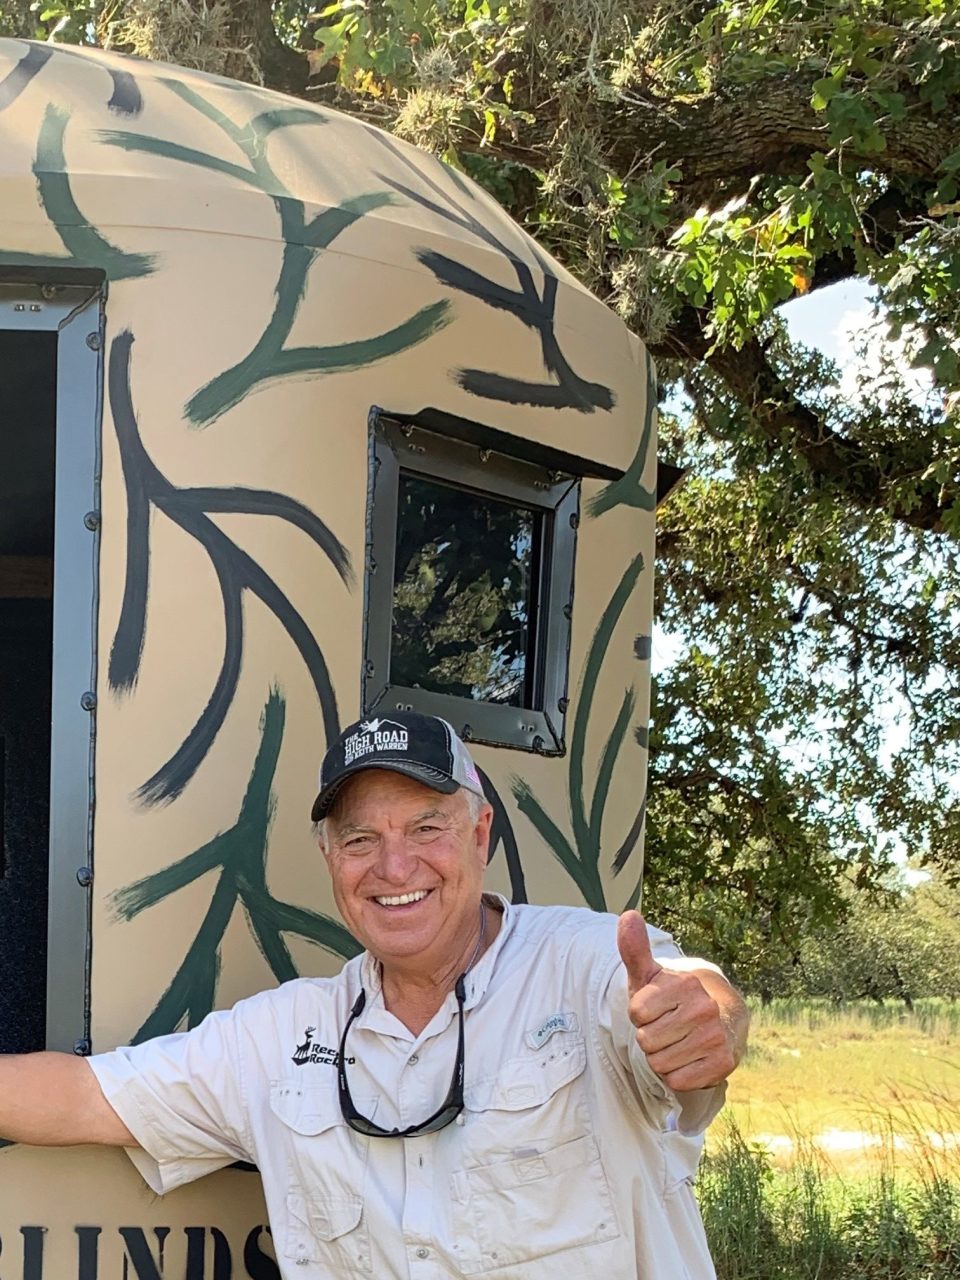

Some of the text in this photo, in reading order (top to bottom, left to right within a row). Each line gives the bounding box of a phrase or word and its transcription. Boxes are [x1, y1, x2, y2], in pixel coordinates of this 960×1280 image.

[344, 732, 359, 747] THE
[344, 730, 409, 757] HIGH ROAD
[354, 742, 409, 760] KEITH WARREN
